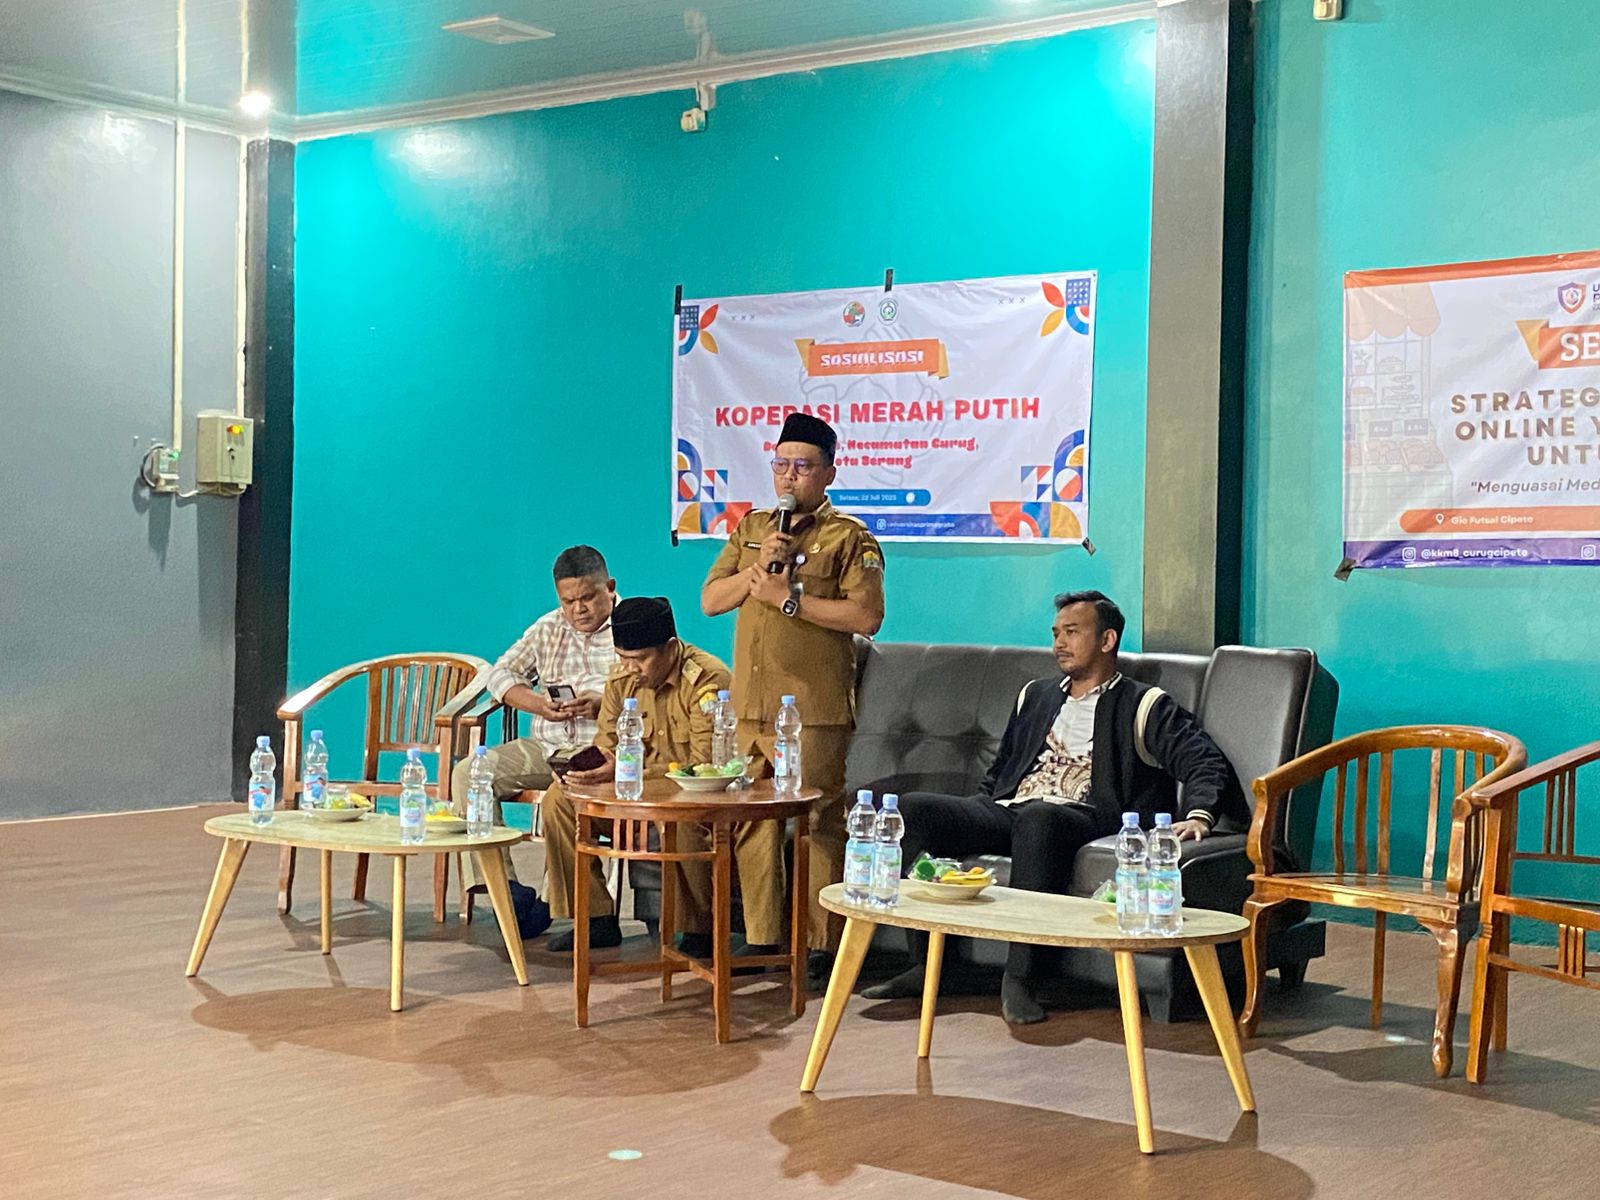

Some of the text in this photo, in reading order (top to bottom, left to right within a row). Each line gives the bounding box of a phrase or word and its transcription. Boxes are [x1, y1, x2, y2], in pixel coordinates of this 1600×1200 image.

[850, 400, 944, 423] MERAH
[954, 397, 1040, 420] PUTIH
[1451, 387, 1600, 414] STRATEG
[1455, 417, 1575, 441] ONLINE
[847, 439, 929, 451] Kecamatan
[931, 437, 980, 452] Curug,
[835, 454, 913, 469] ota Serang
[1527, 444, 1600, 466] UNT
[1471, 478, 1563, 495] "Menguasai
[1450, 516, 1468, 525] Gio
[1469, 515, 1498, 524] Futsal
